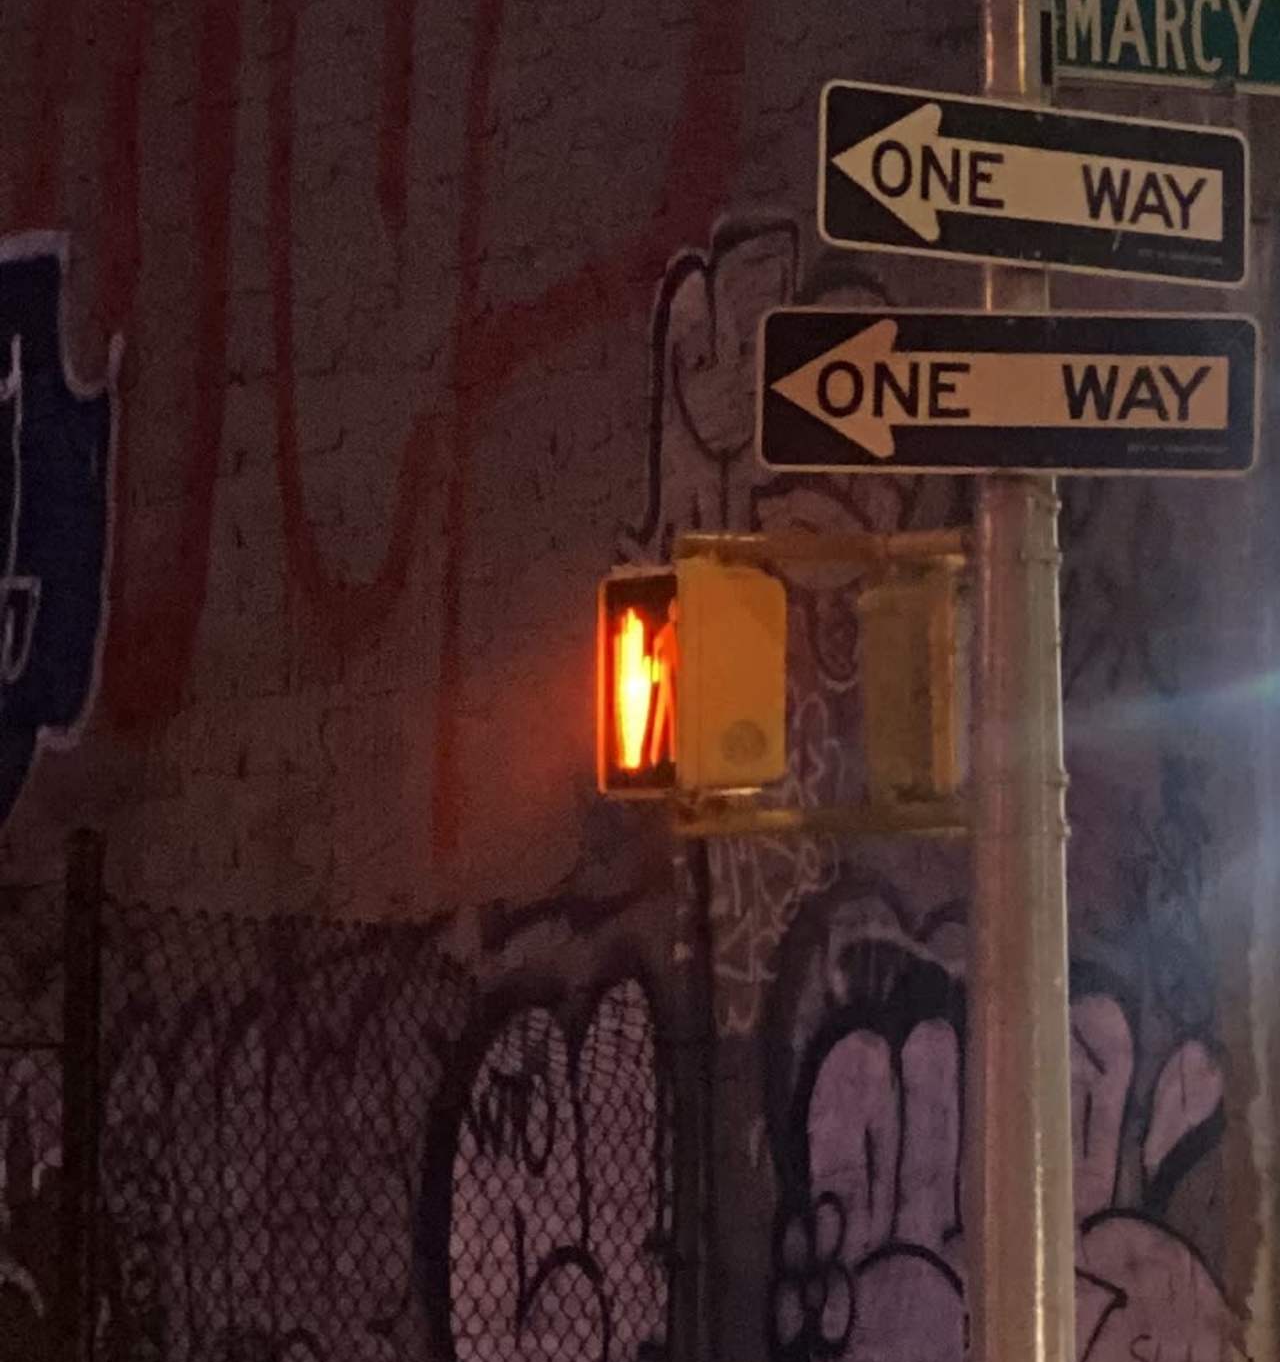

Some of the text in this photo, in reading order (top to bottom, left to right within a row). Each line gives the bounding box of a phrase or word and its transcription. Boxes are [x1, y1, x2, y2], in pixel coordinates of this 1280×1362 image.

[871, 139, 1206, 231] ONE WAY
[816, 360, 1212, 422] ONE WAY
